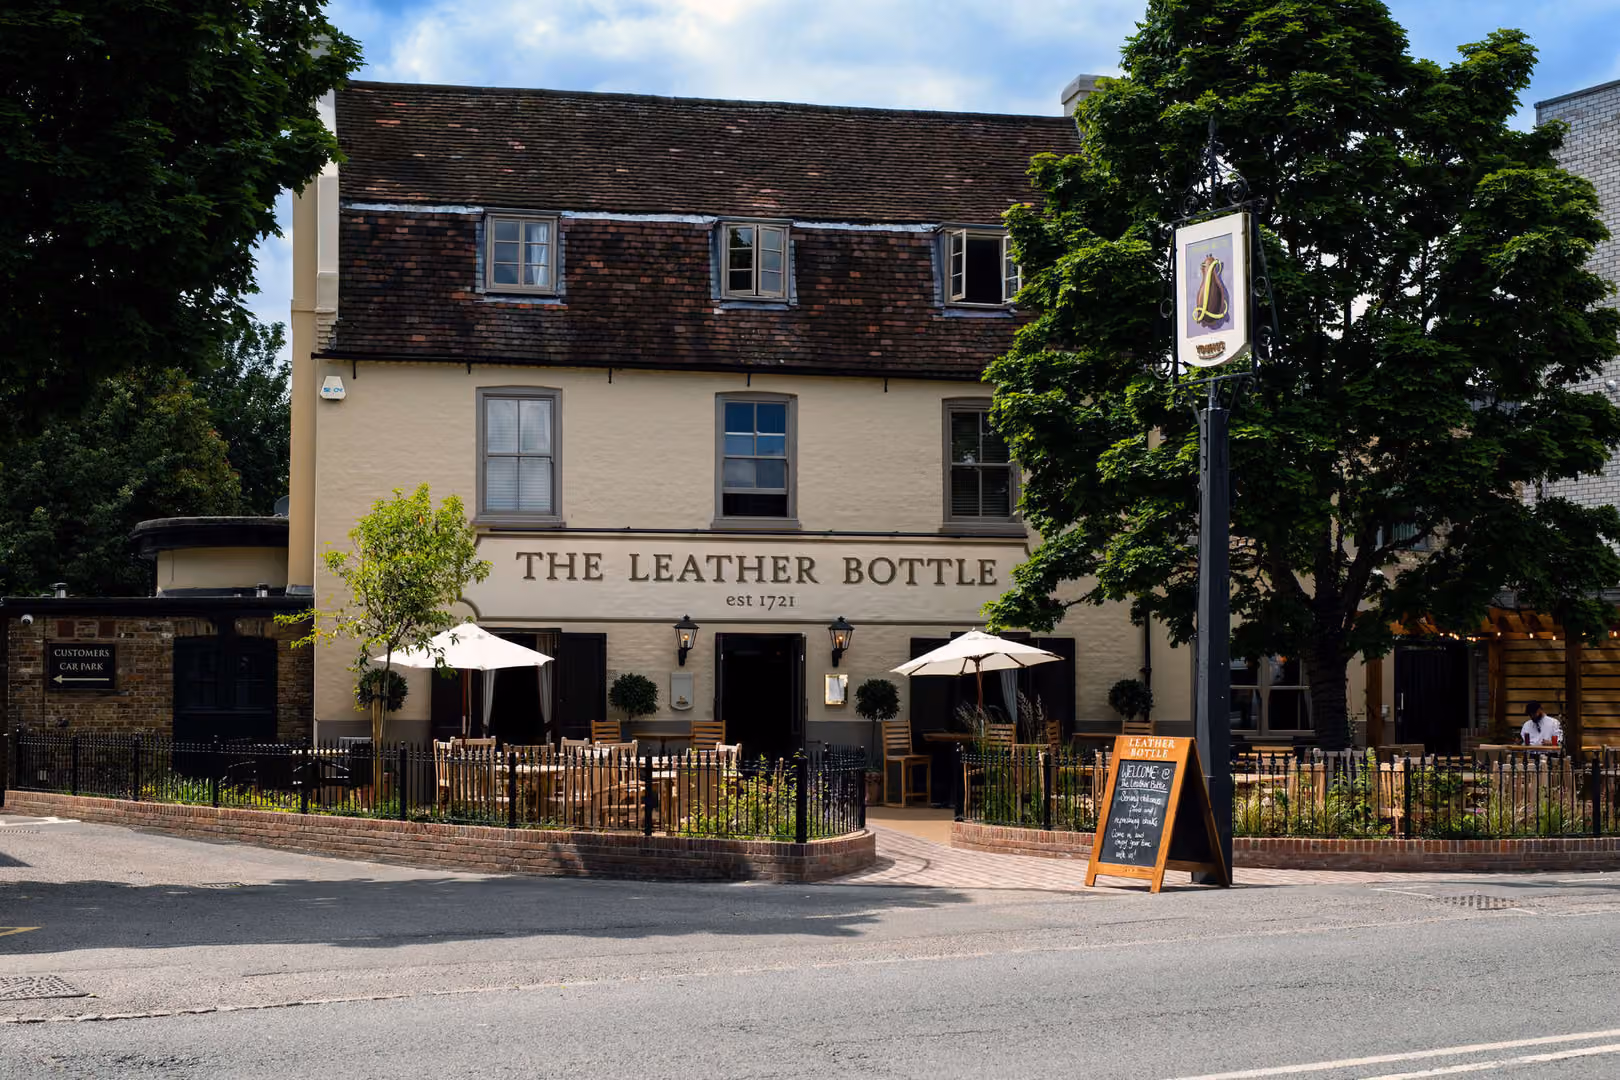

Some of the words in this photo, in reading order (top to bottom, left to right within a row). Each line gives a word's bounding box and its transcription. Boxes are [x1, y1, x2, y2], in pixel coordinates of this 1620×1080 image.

[515, 551, 604, 581] THE
[627, 552, 820, 584] LEATHER
[842, 556, 998, 587] BOTTLE
[726, 595, 753, 607] est
[759, 595, 795, 611] 1721
[54, 648, 110, 657] CUSTOMERS
[59, 662, 79, 671] CAR
[80, 662, 104, 671] PARK
[1129, 738, 1175, 749] LEATHER
[1130, 748, 1169, 758] BOTTLE
[1121, 763, 1159, 779] WELCOME
